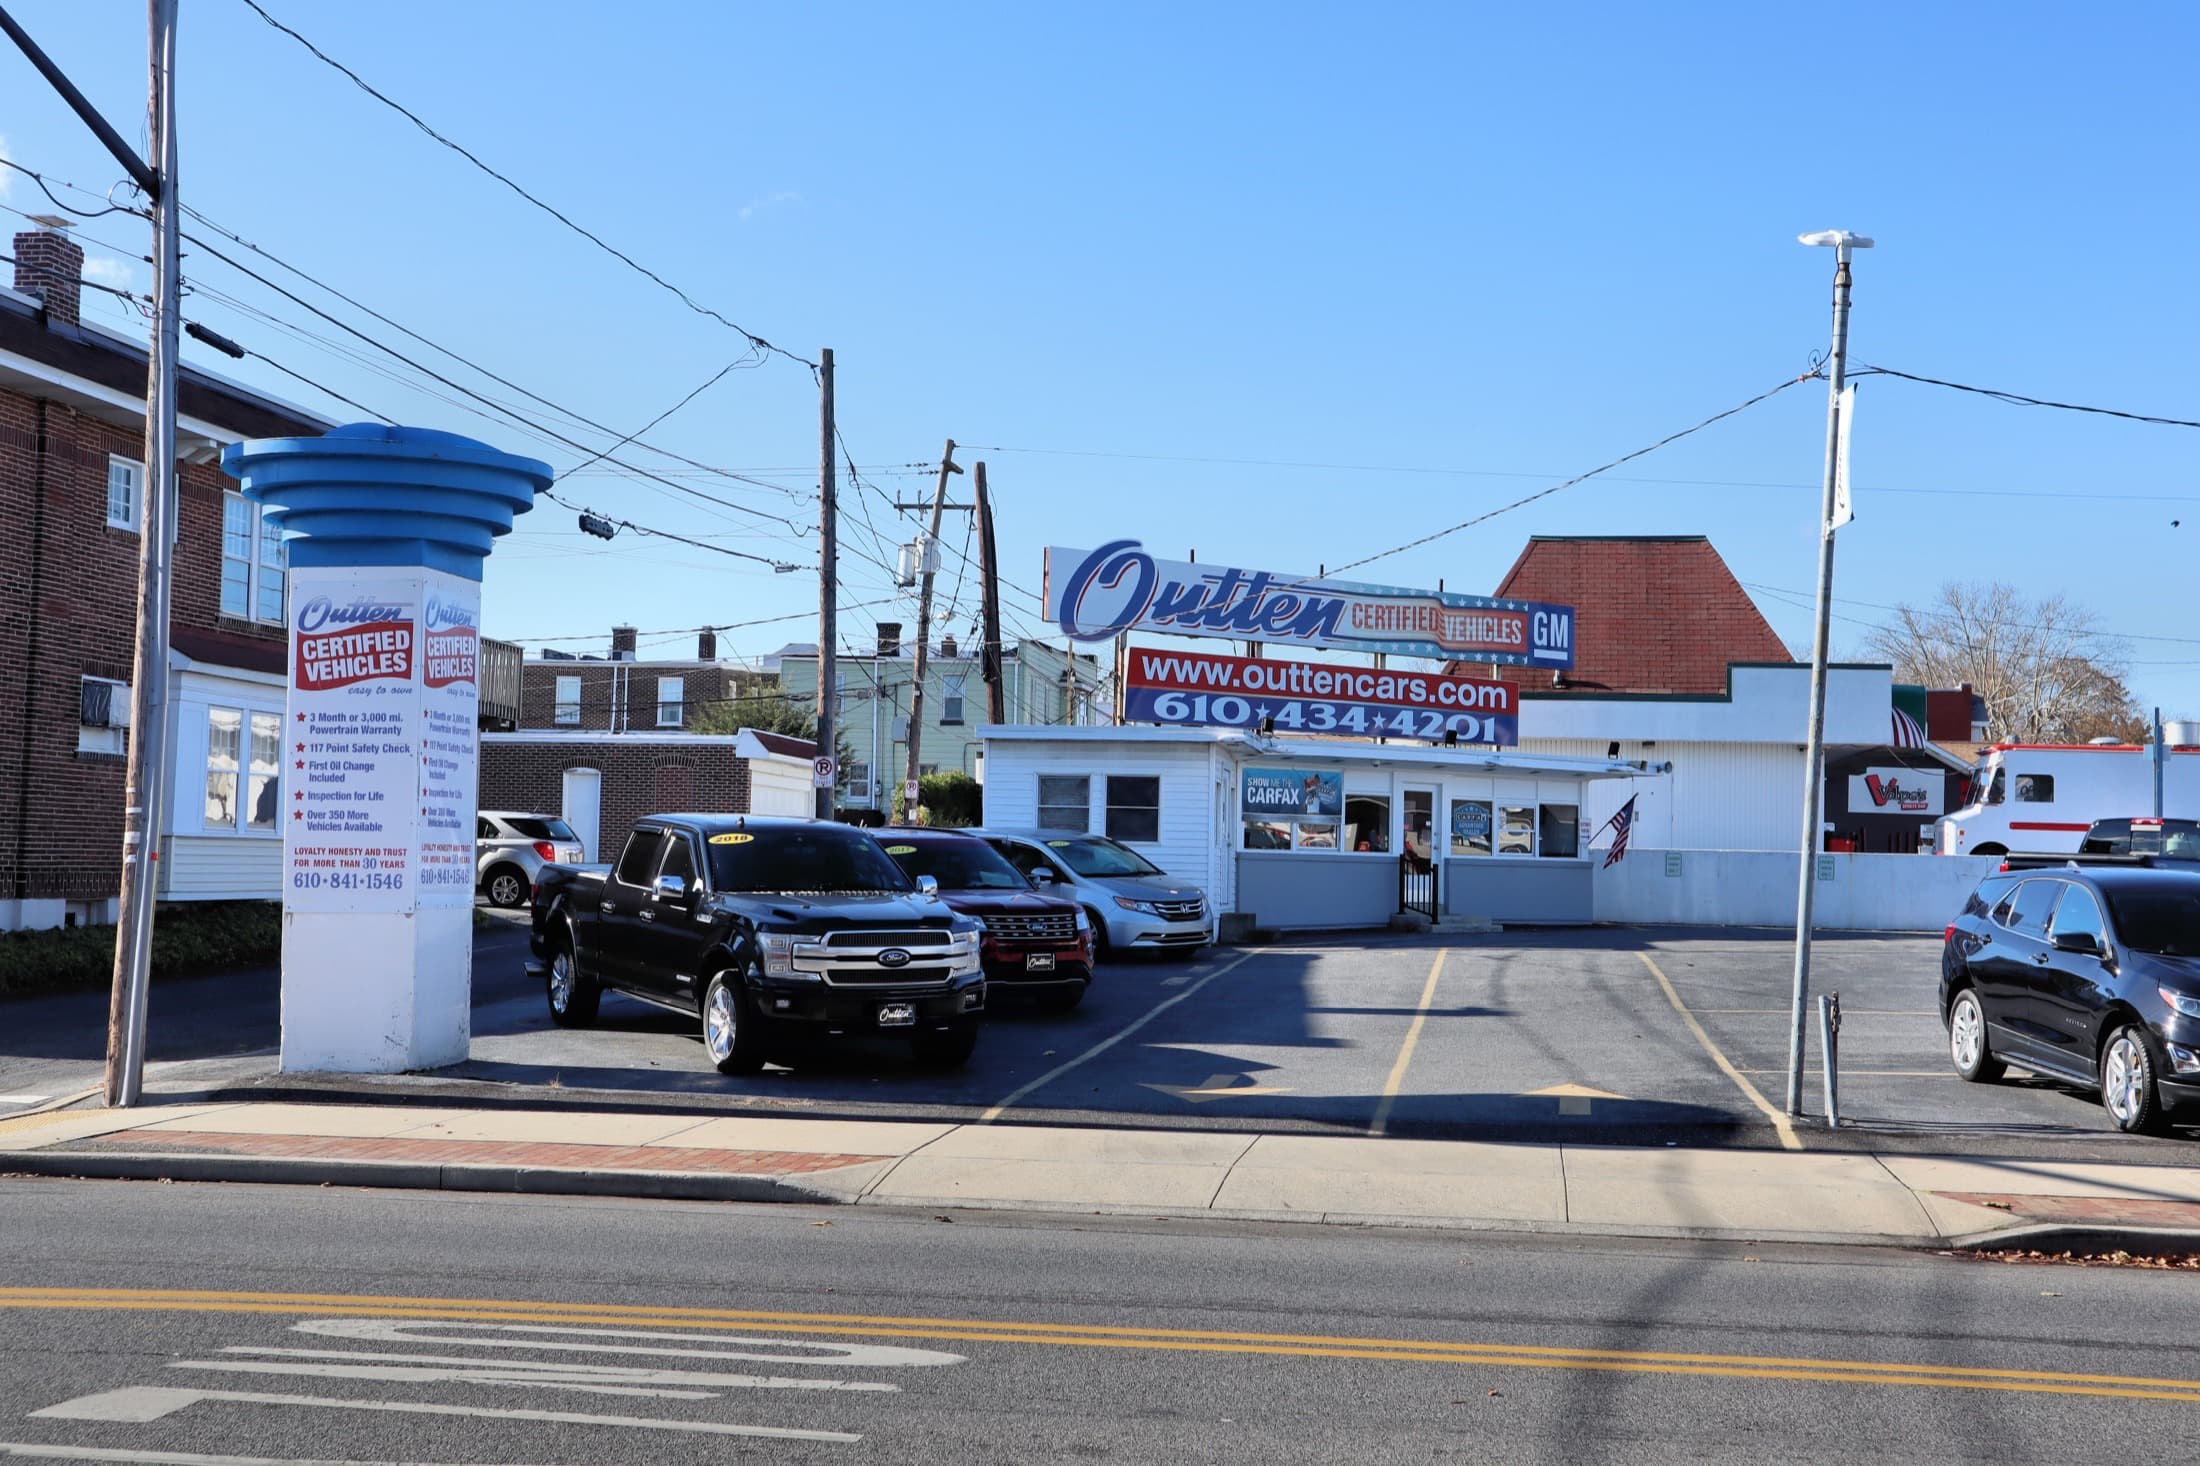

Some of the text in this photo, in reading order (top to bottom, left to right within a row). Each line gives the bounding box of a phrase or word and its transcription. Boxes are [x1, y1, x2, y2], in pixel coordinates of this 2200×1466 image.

[1059, 539, 1569, 649] Outten CERTIFIED VEHICLES GM
[298, 595, 414, 632] Outten
[302, 630, 410, 660] CERTIFIED
[427, 635, 475, 657] CERTIFIED
[304, 652, 408, 682] VEHICLES
[428, 657, 474, 679] VEHICLES
[1142, 655, 1507, 710] www.outtencars.com
[348, 686, 413, 697] easy to own
[310, 712, 316, 722] 3
[318, 712, 344, 722] Month
[361, 713, 387, 723] 3,000
[389, 713, 404, 722] mi.
[1153, 692, 1251, 725] 610
[1274, 701, 1369, 733] 434
[309, 725, 402, 736] Powertrain Warranty
[310, 743, 410, 755] 117 Point Safety Check
[309, 761, 375, 773] First Oil Change
[308, 773, 346, 783] Included
[1247, 778, 1269, 787] SHOW
[308, 791, 385, 802] Inspection for Life
[1247, 788, 1300, 805] CARFAX
[307, 810, 369, 820] Over 350 More
[307, 821, 383, 832] Vehicles Available
[294, 847, 407, 857] LOYALTY HONESTY AND TRUST
[294, 857, 406, 870] FOR MORE THAN 30 YEARS
[880, 1008, 912, 1021] Outten
